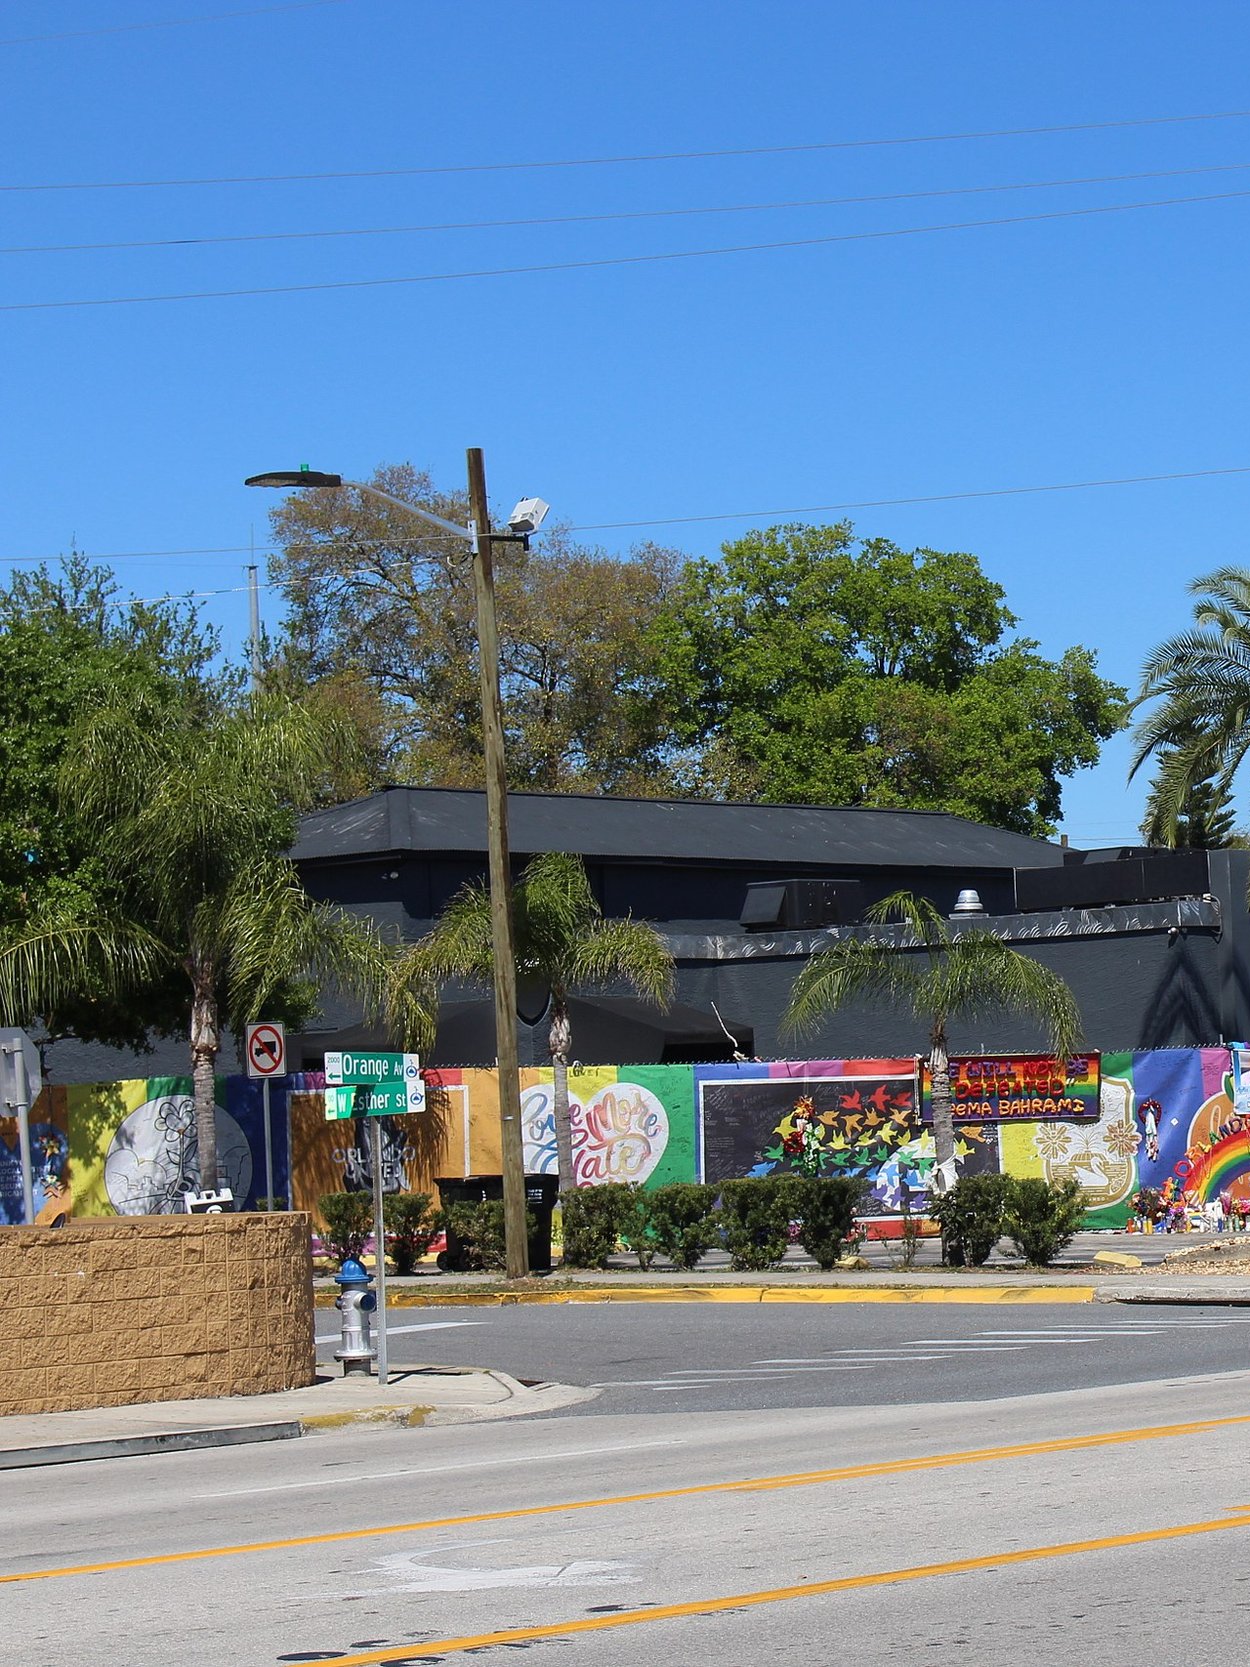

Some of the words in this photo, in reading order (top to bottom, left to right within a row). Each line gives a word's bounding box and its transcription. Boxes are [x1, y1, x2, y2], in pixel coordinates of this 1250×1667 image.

[343, 1054, 389, 1082] Orange
[393, 1061, 404, 1076] Av
[966, 1060, 1016, 1077] WILL
[337, 1093, 347, 1113] W
[351, 1091, 390, 1111] Esther
[395, 1092, 406, 1107] St
[999, 1098, 1085, 1116] BAHRAMI
[332, 1146, 416, 1163] ORLNDO
